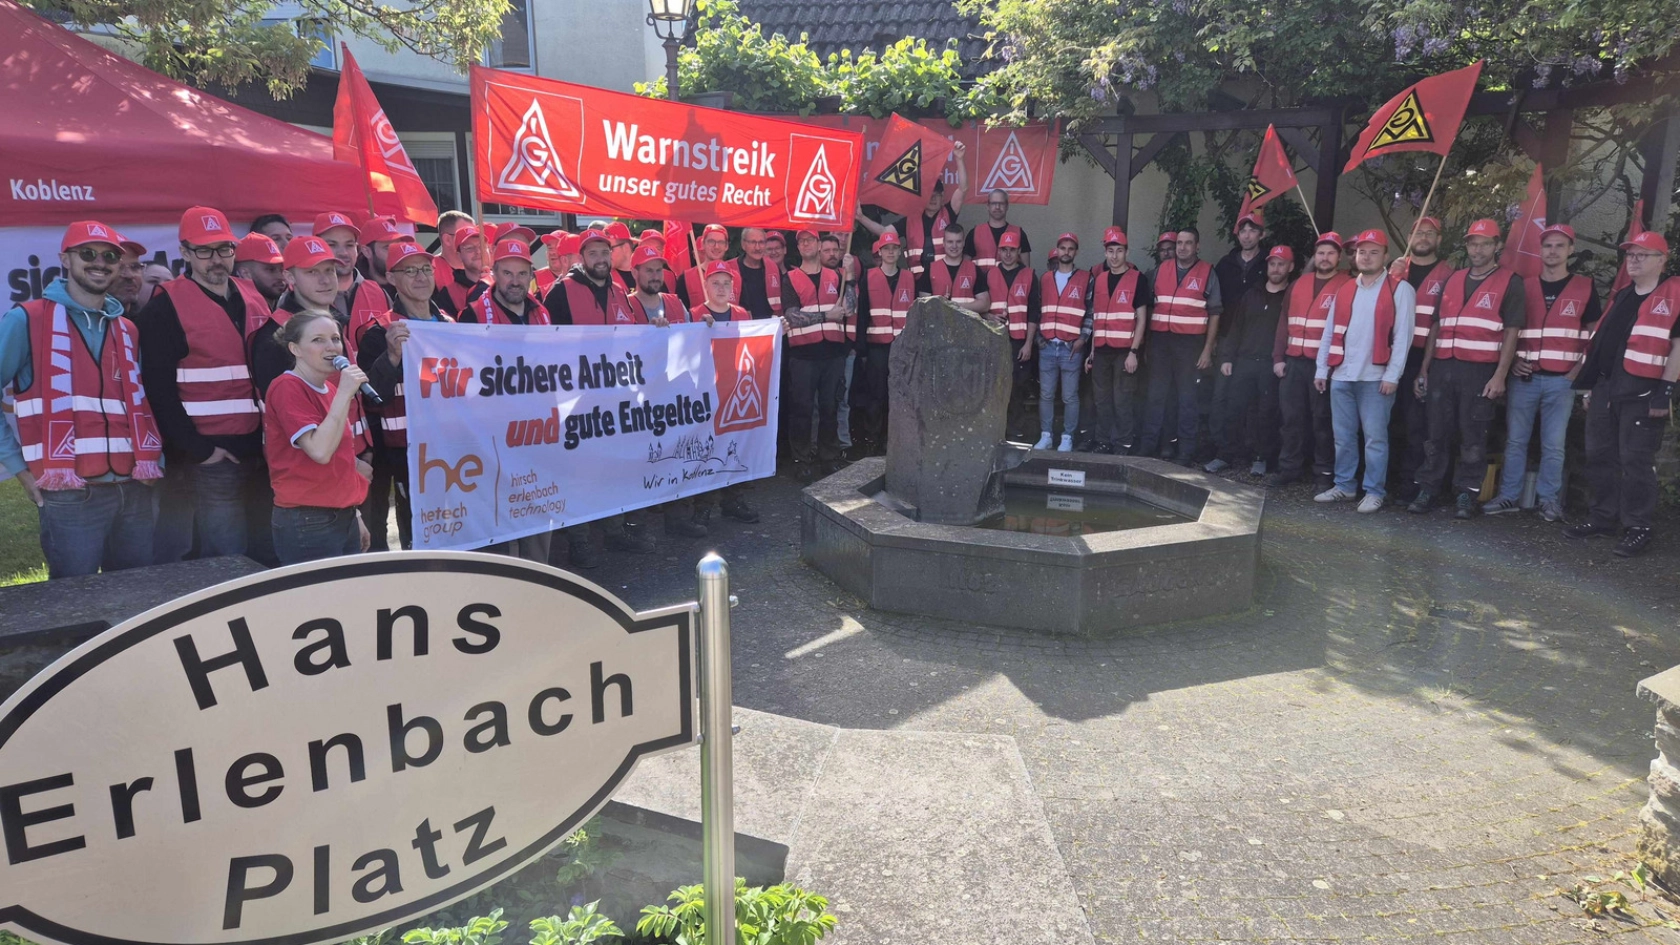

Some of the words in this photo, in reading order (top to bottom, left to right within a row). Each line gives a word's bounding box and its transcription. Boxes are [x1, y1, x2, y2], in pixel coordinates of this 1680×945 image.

[602, 119, 777, 178] Warnstreik
[9, 178, 96, 201] Koblenz
[598, 174, 661, 198] unser
[663, 178, 718, 205] gutes
[721, 186, 772, 207] Recht
[418, 356, 474, 399] Für
[478, 355, 574, 398] sichere
[578, 352, 646, 390] Arbeit
[505, 407, 560, 448] und
[563, 404, 616, 451] gute
[618, 391, 712, 437] Entgelte!
[418, 442, 484, 494] he
[510, 469, 538, 488] hirsch
[643, 474, 665, 490] Wir
[668, 472, 678, 485] in
[508, 482, 559, 504] erlenbach
[509, 498, 567, 520] technology
[420, 502, 468, 524] hetech
[423, 521, 463, 545] group
[172, 600, 503, 711] Hans
[0, 660, 635, 866] Erlenbach
[221, 804, 508, 931] Platz
